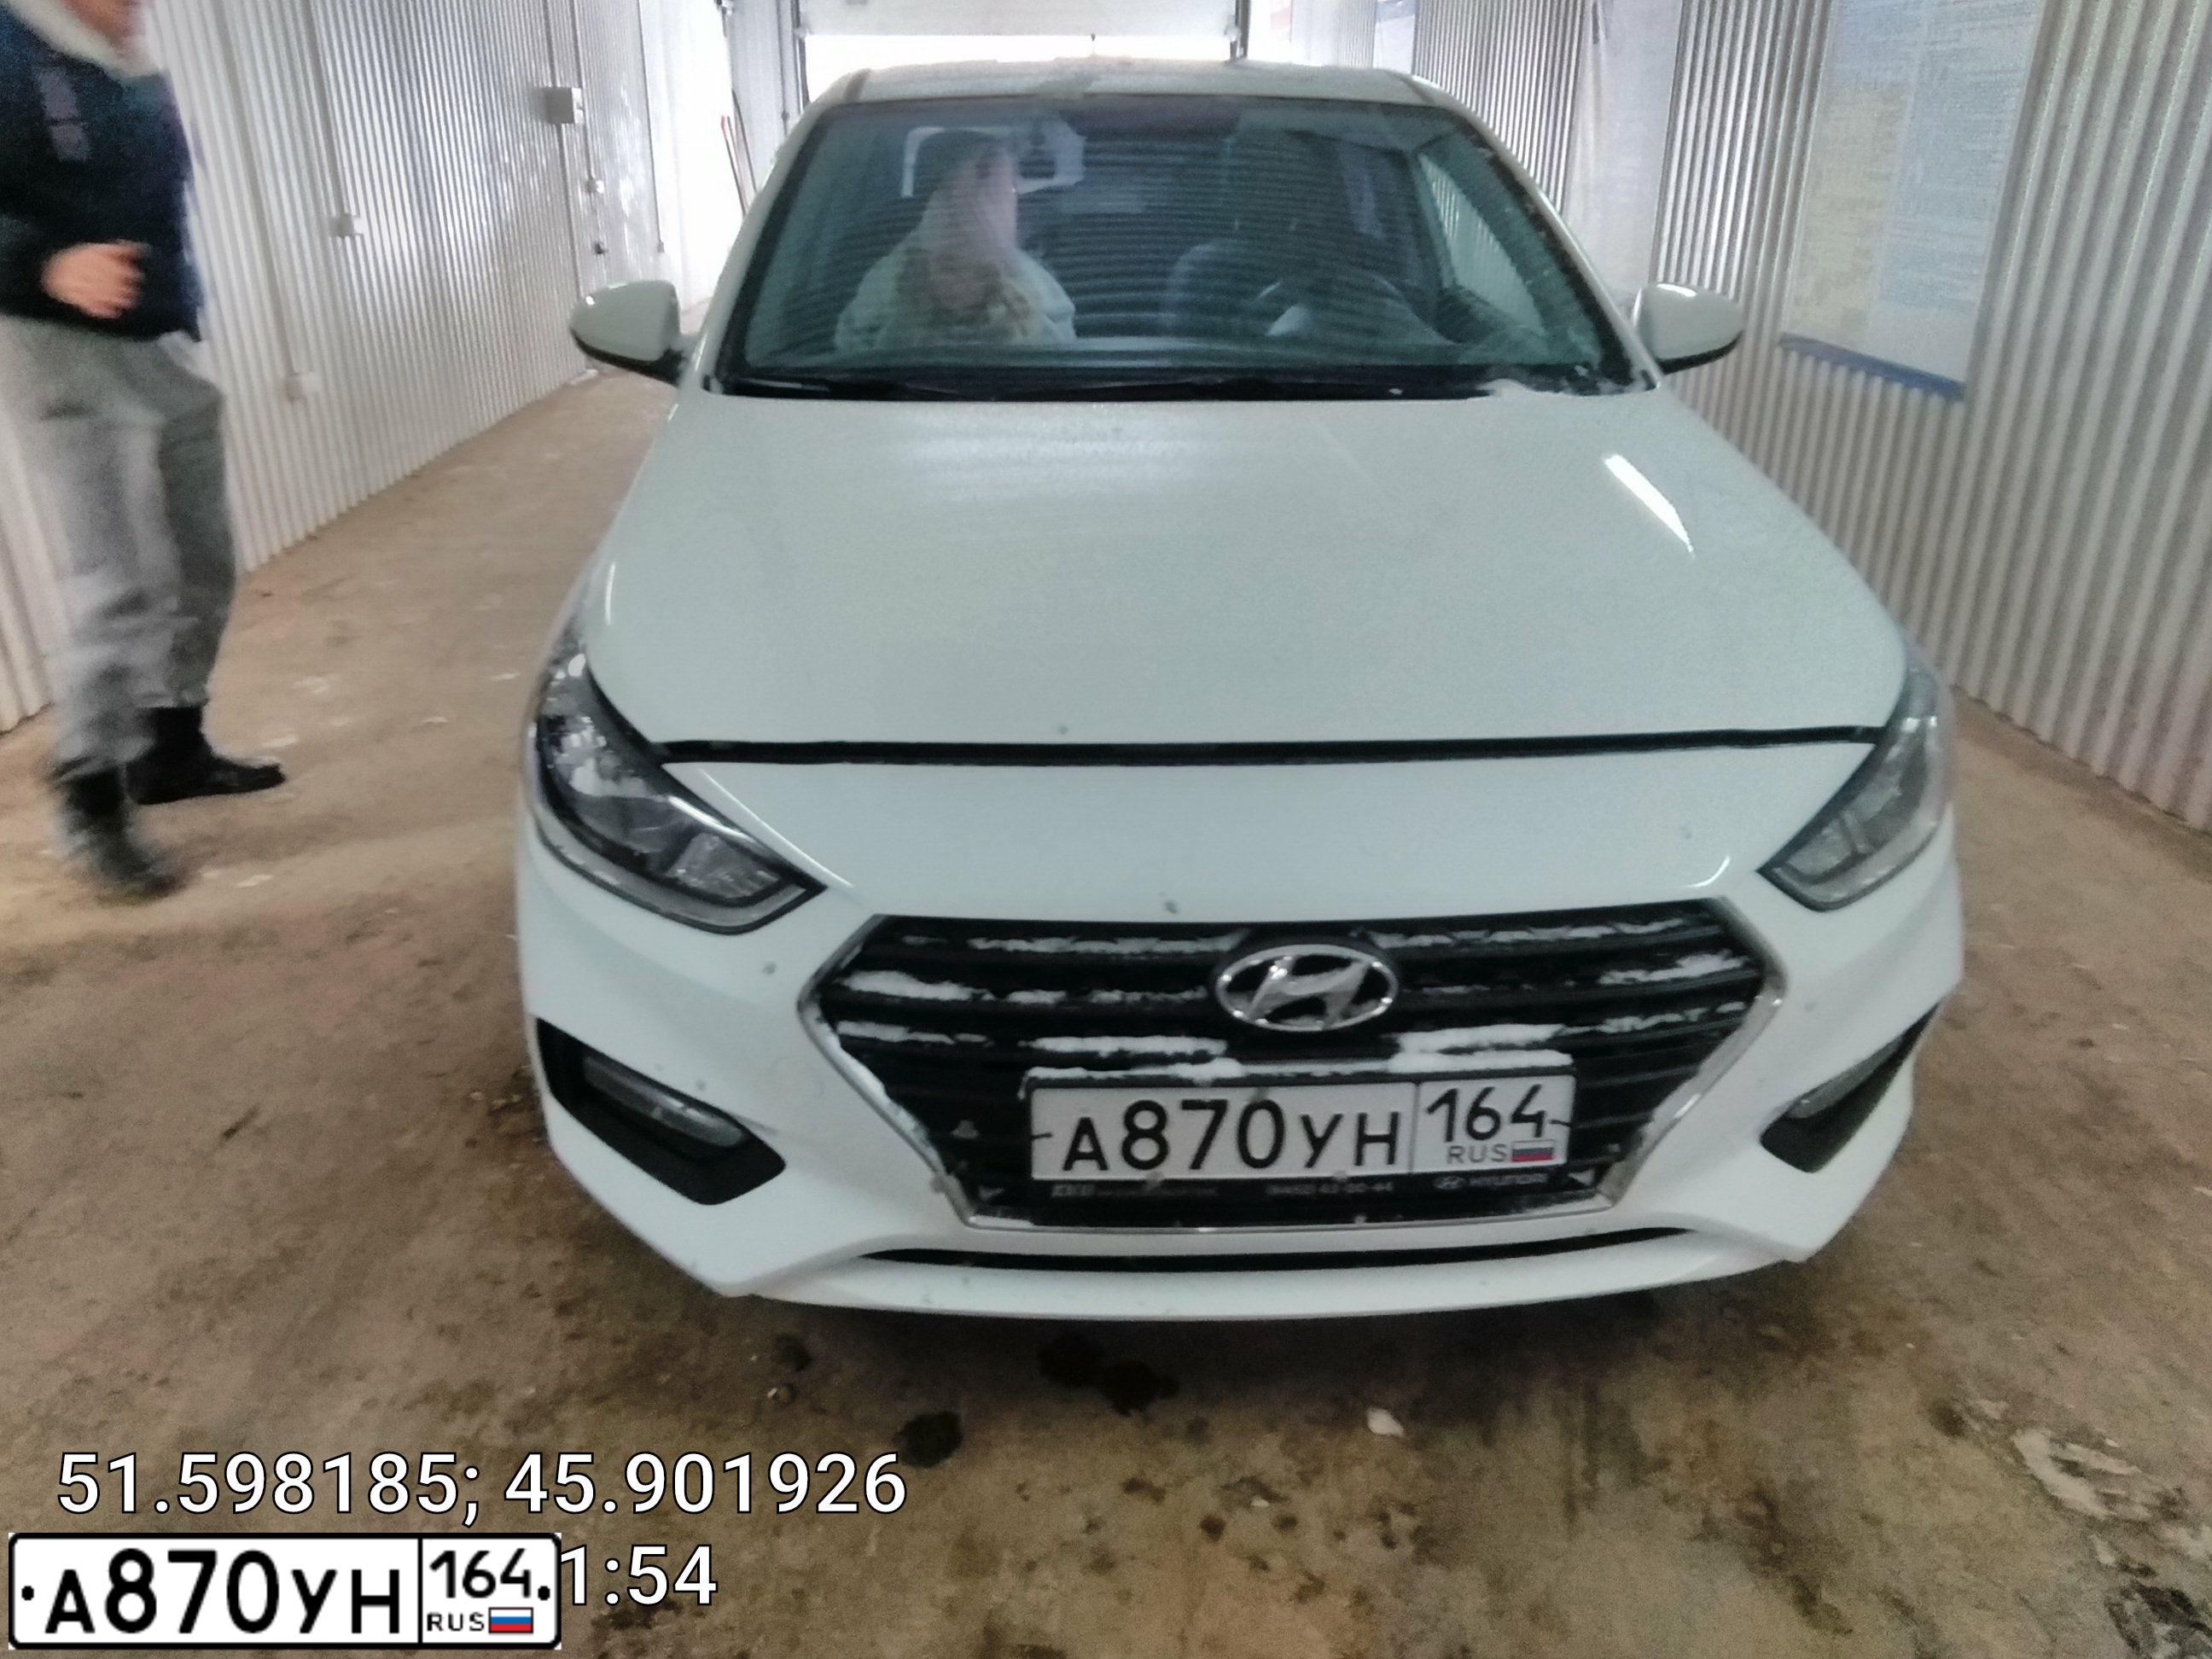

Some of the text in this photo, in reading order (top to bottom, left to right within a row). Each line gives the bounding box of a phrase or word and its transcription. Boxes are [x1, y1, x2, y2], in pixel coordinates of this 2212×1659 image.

[1062, 1084, 1545, 1172] А870УН 164
[1447, 1144, 1508, 1165] RUS
